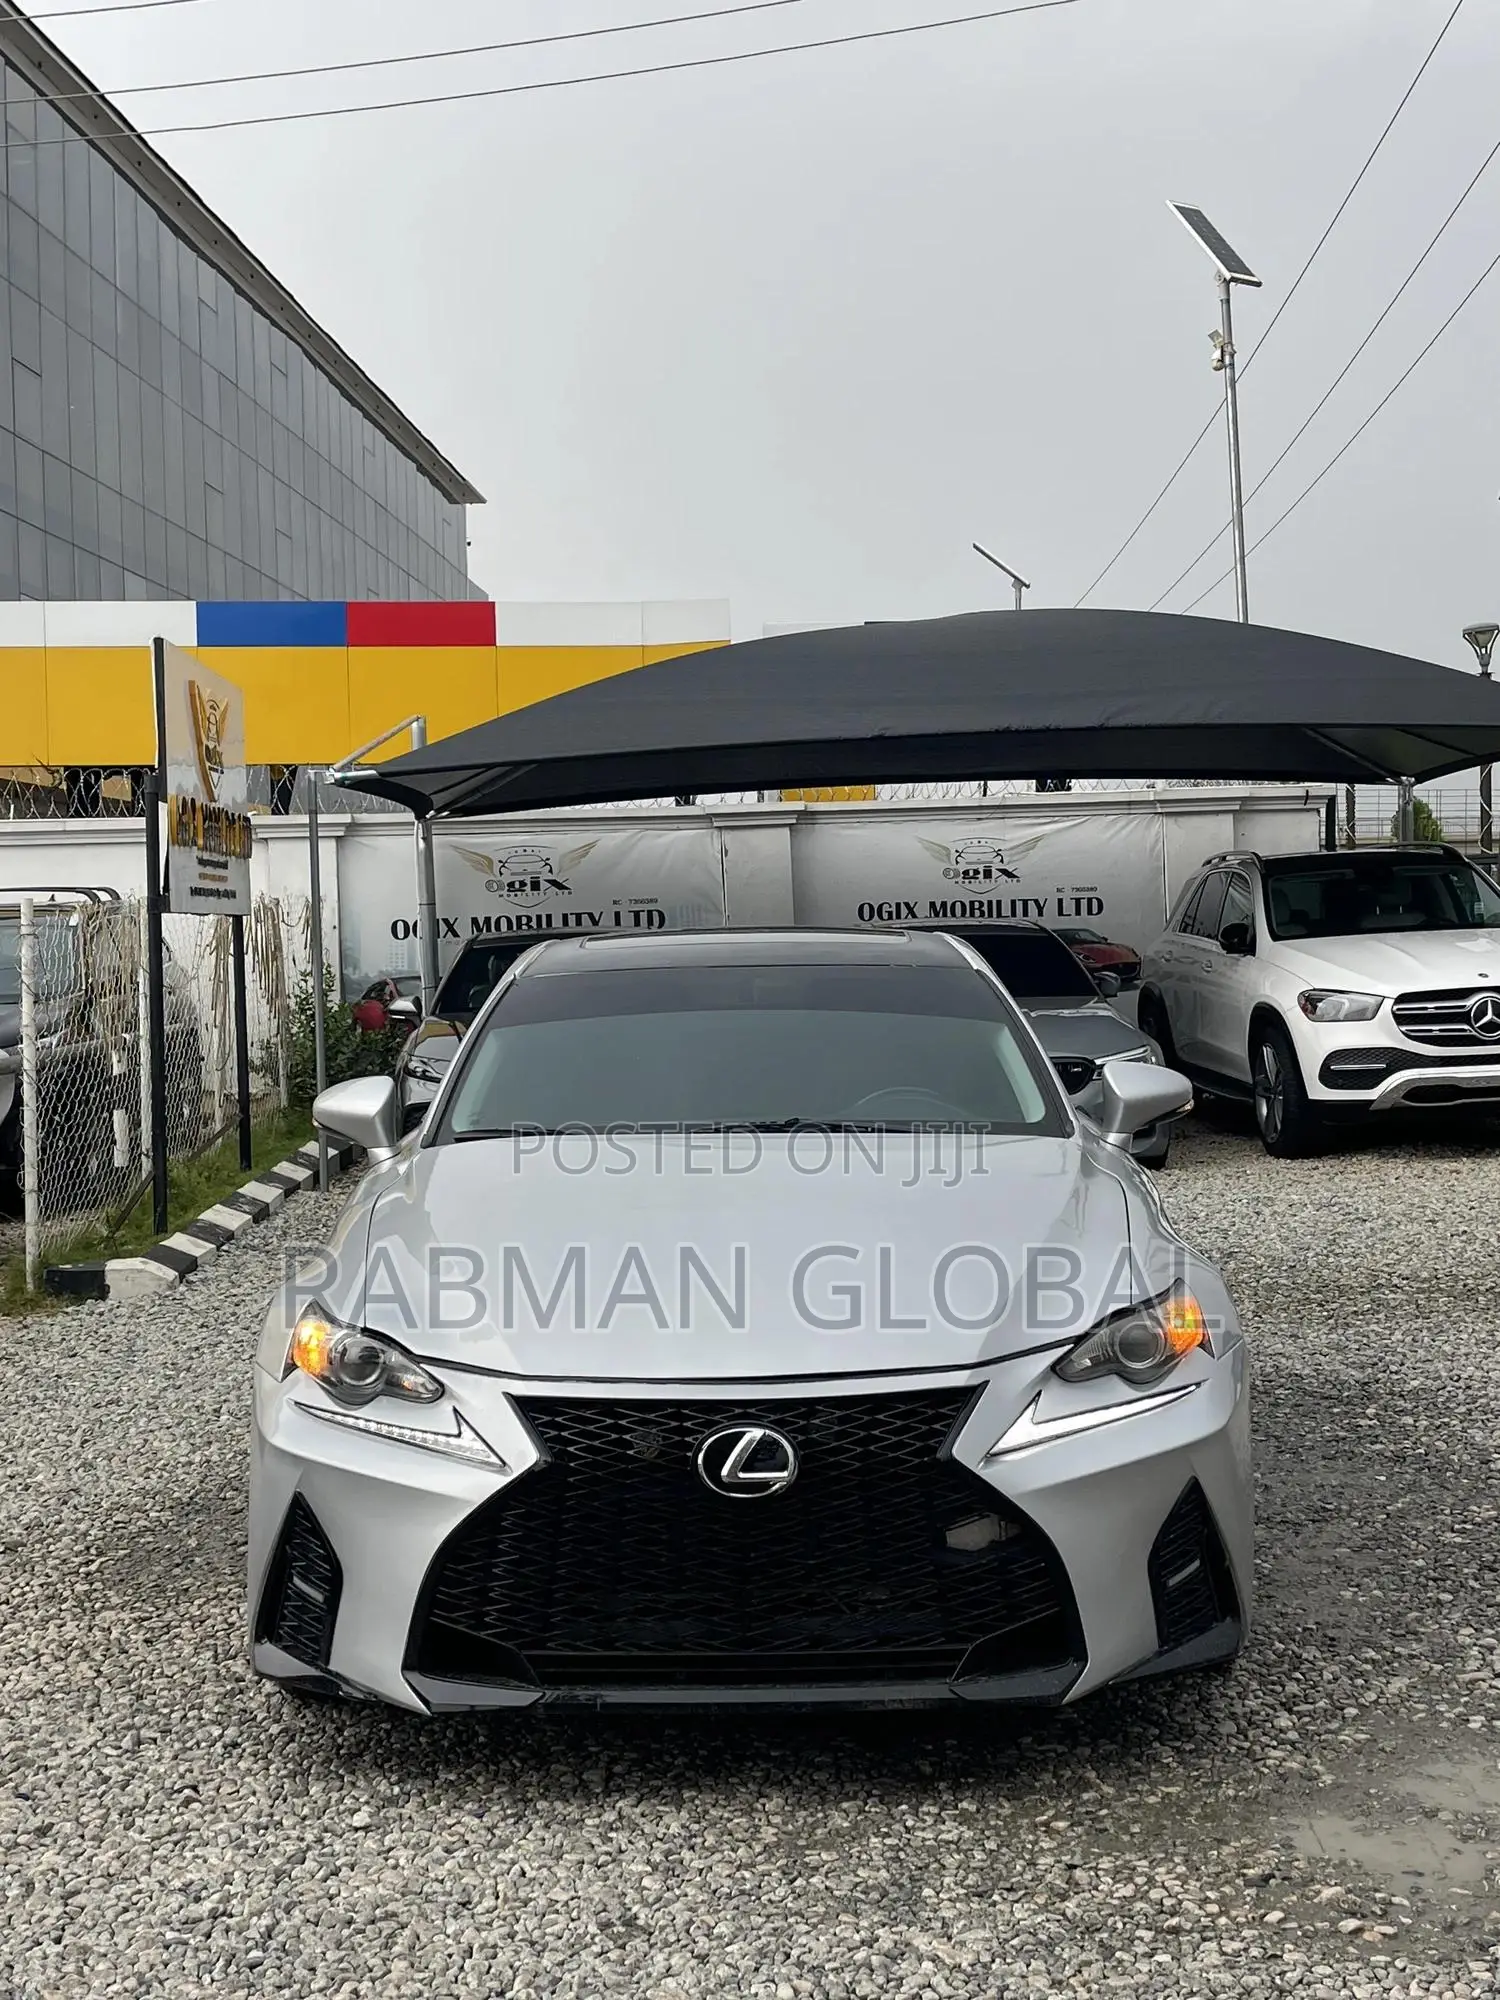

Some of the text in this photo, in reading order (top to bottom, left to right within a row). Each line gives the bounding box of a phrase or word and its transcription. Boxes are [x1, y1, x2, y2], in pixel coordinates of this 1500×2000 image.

[857, 896, 1105, 921] OGIX MOBILITY LTD
